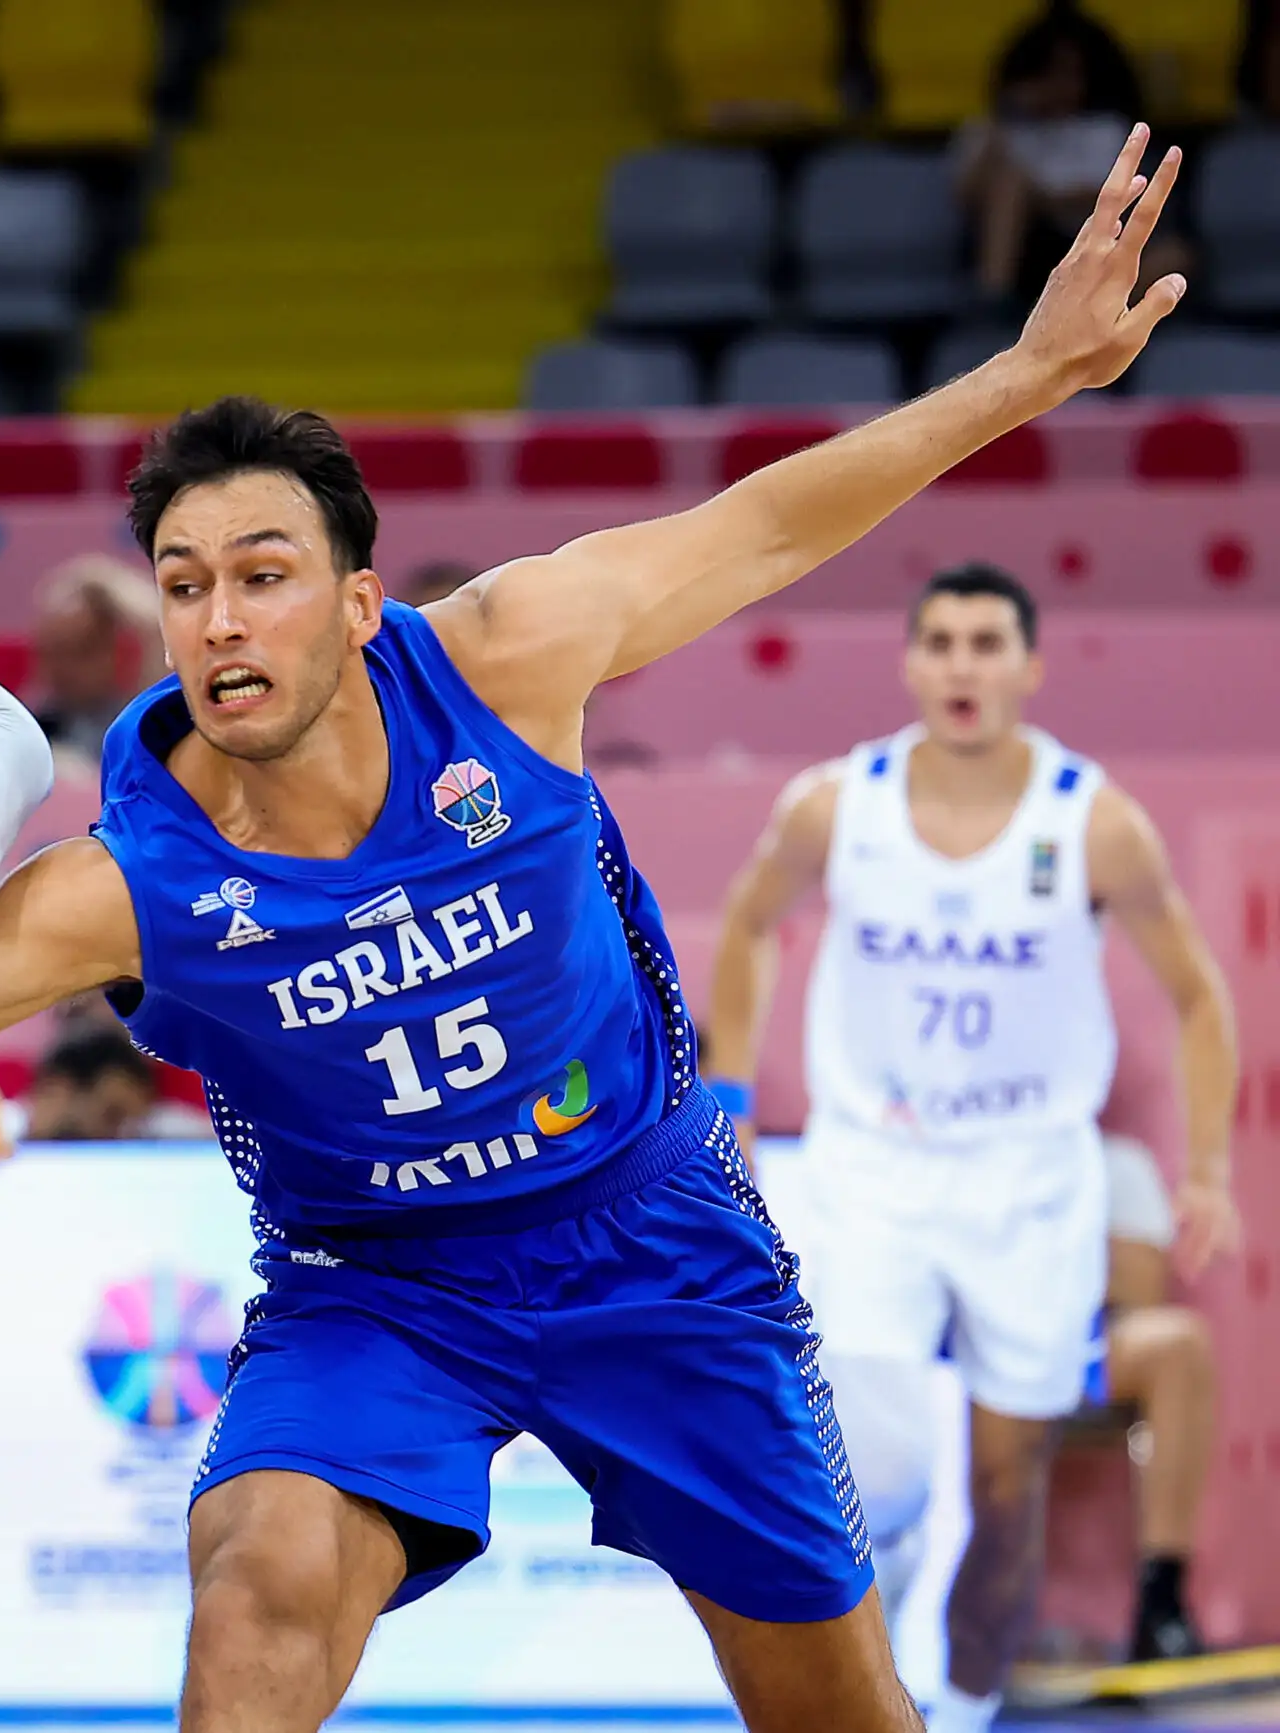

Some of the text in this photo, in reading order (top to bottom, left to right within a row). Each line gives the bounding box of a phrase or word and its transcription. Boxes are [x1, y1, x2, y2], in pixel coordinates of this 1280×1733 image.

[216, 928, 277, 952] PEAK
[266, 881, 534, 1030] ISRAEL
[364, 995, 509, 1116] 15
[913, 988, 993, 1050] 70
